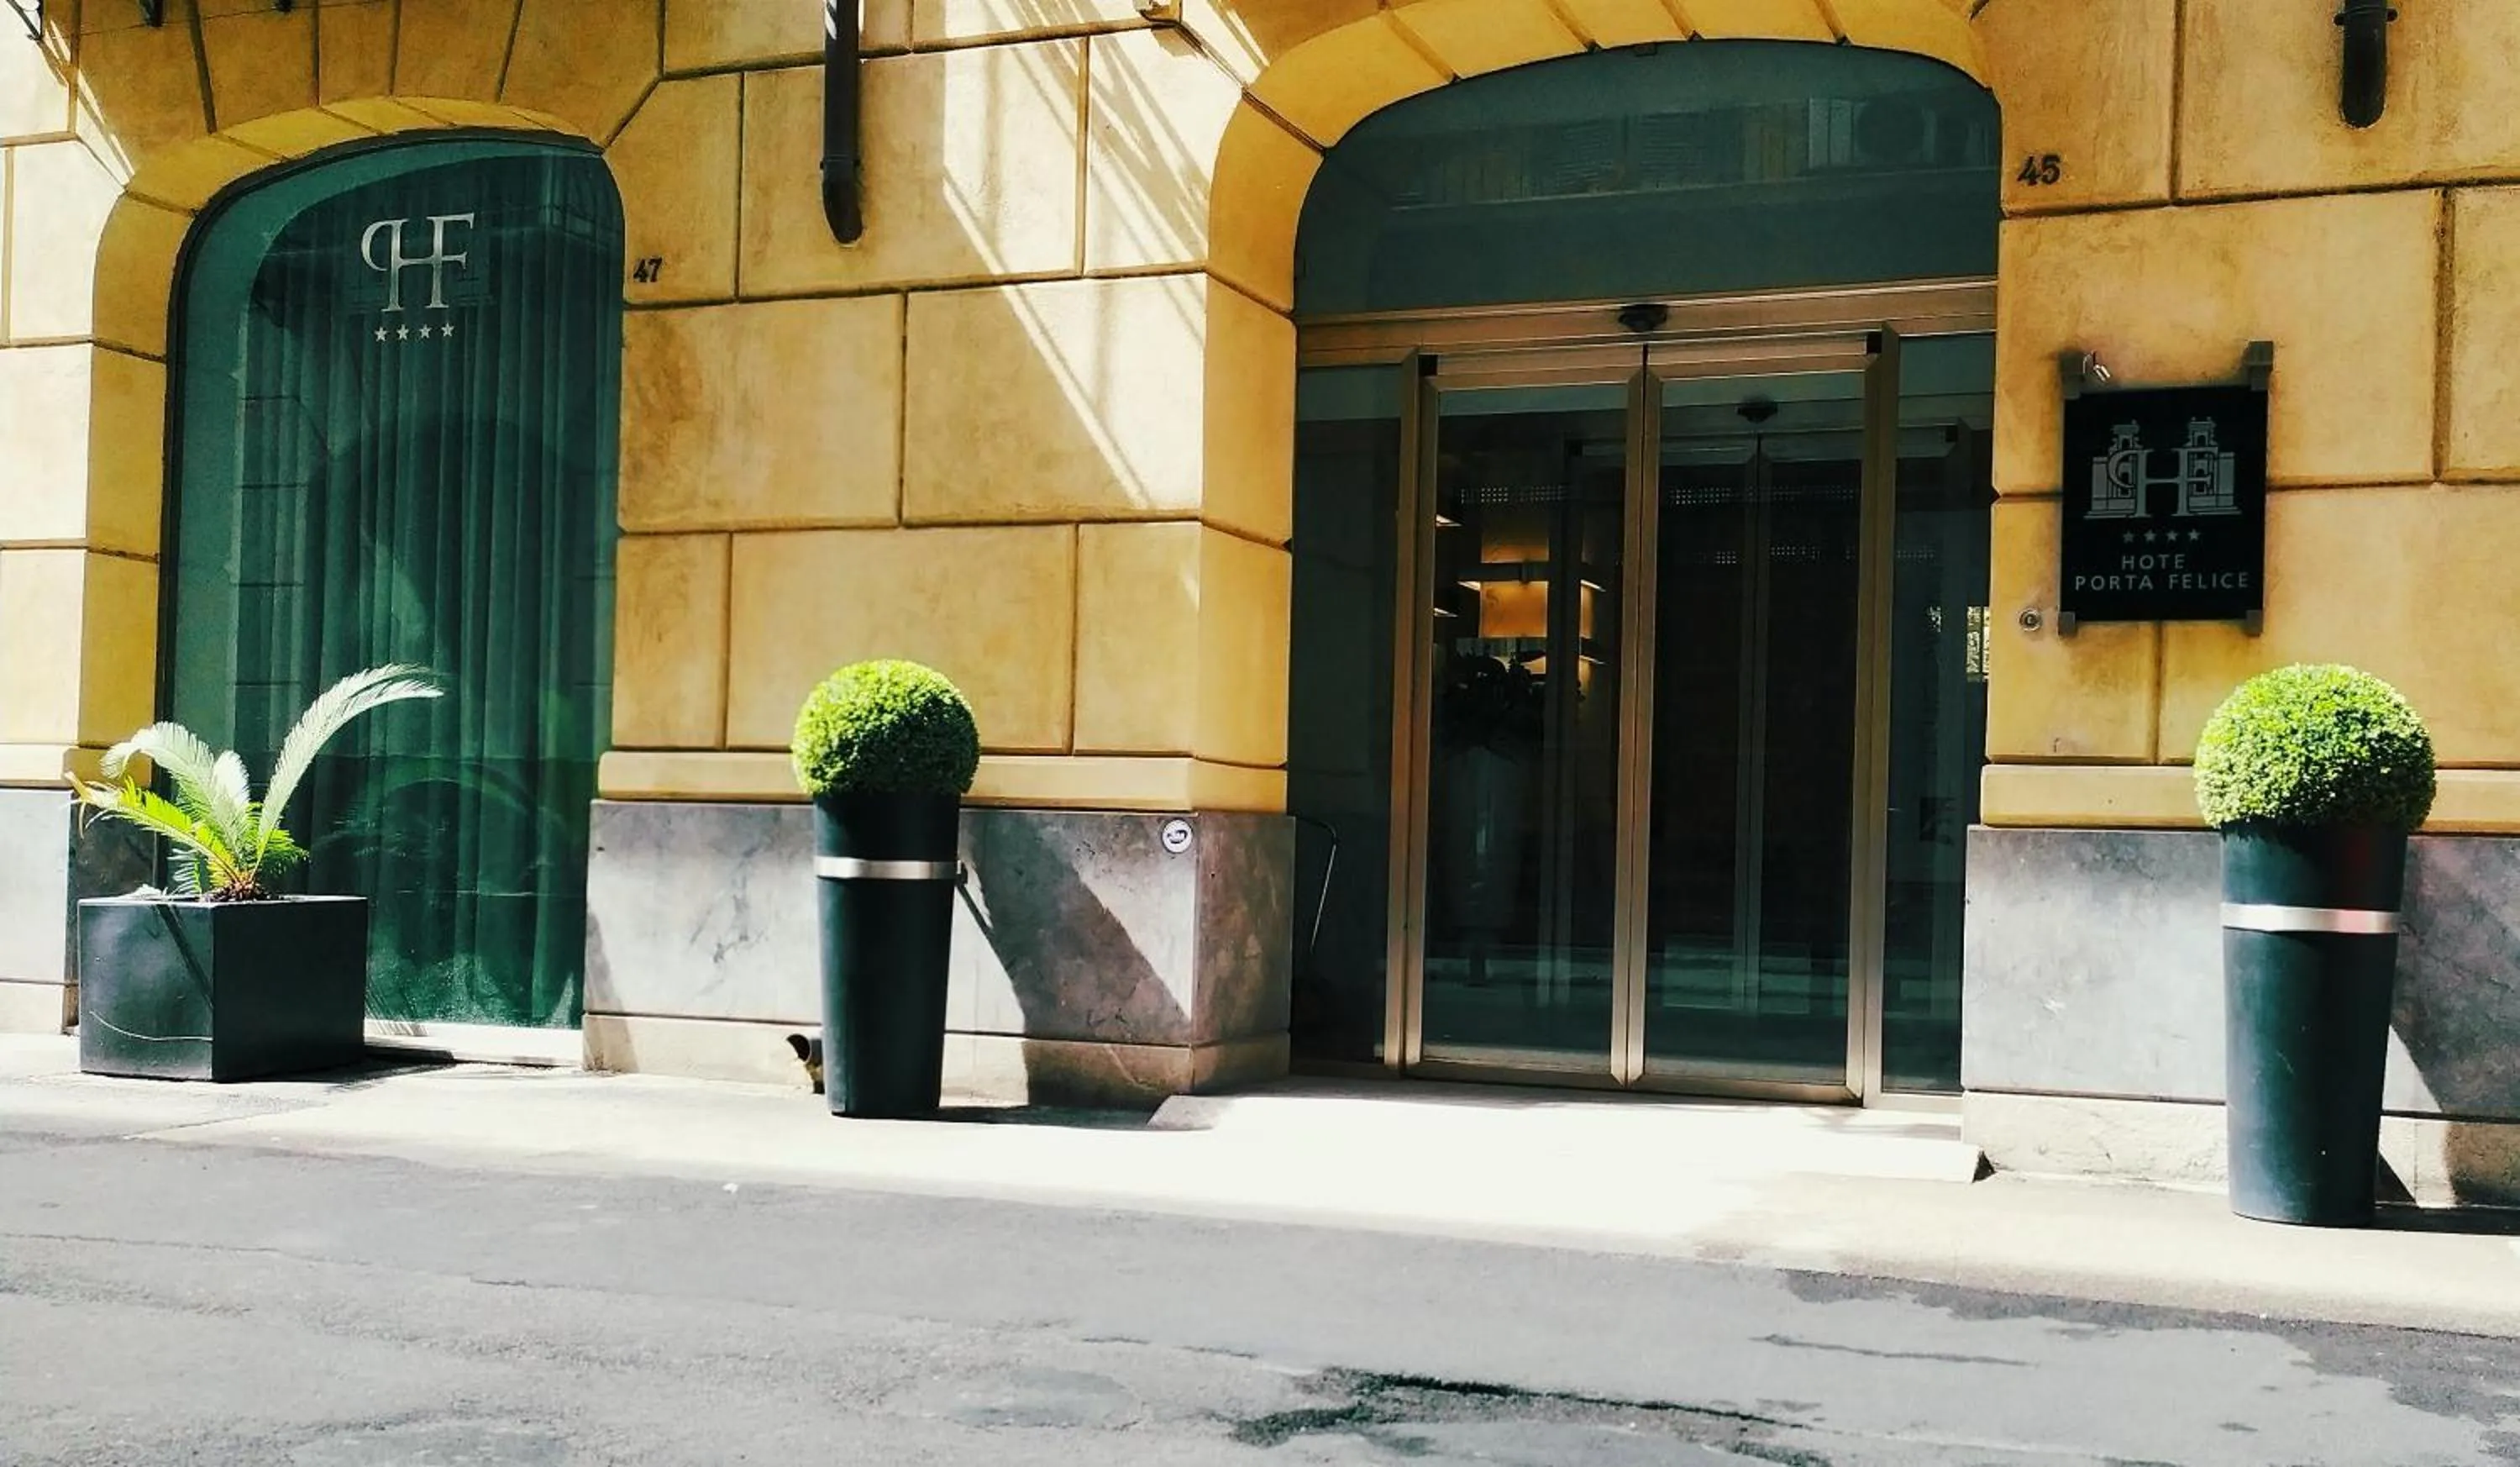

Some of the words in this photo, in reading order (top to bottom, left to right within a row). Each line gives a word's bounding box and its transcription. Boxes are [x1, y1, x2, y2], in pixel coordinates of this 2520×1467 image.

[2017, 155, 2061, 187] 45
[633, 256, 663, 283] 47
[2075, 575, 2154, 591] PORTA
[2169, 572, 2249, 589] FELICE
